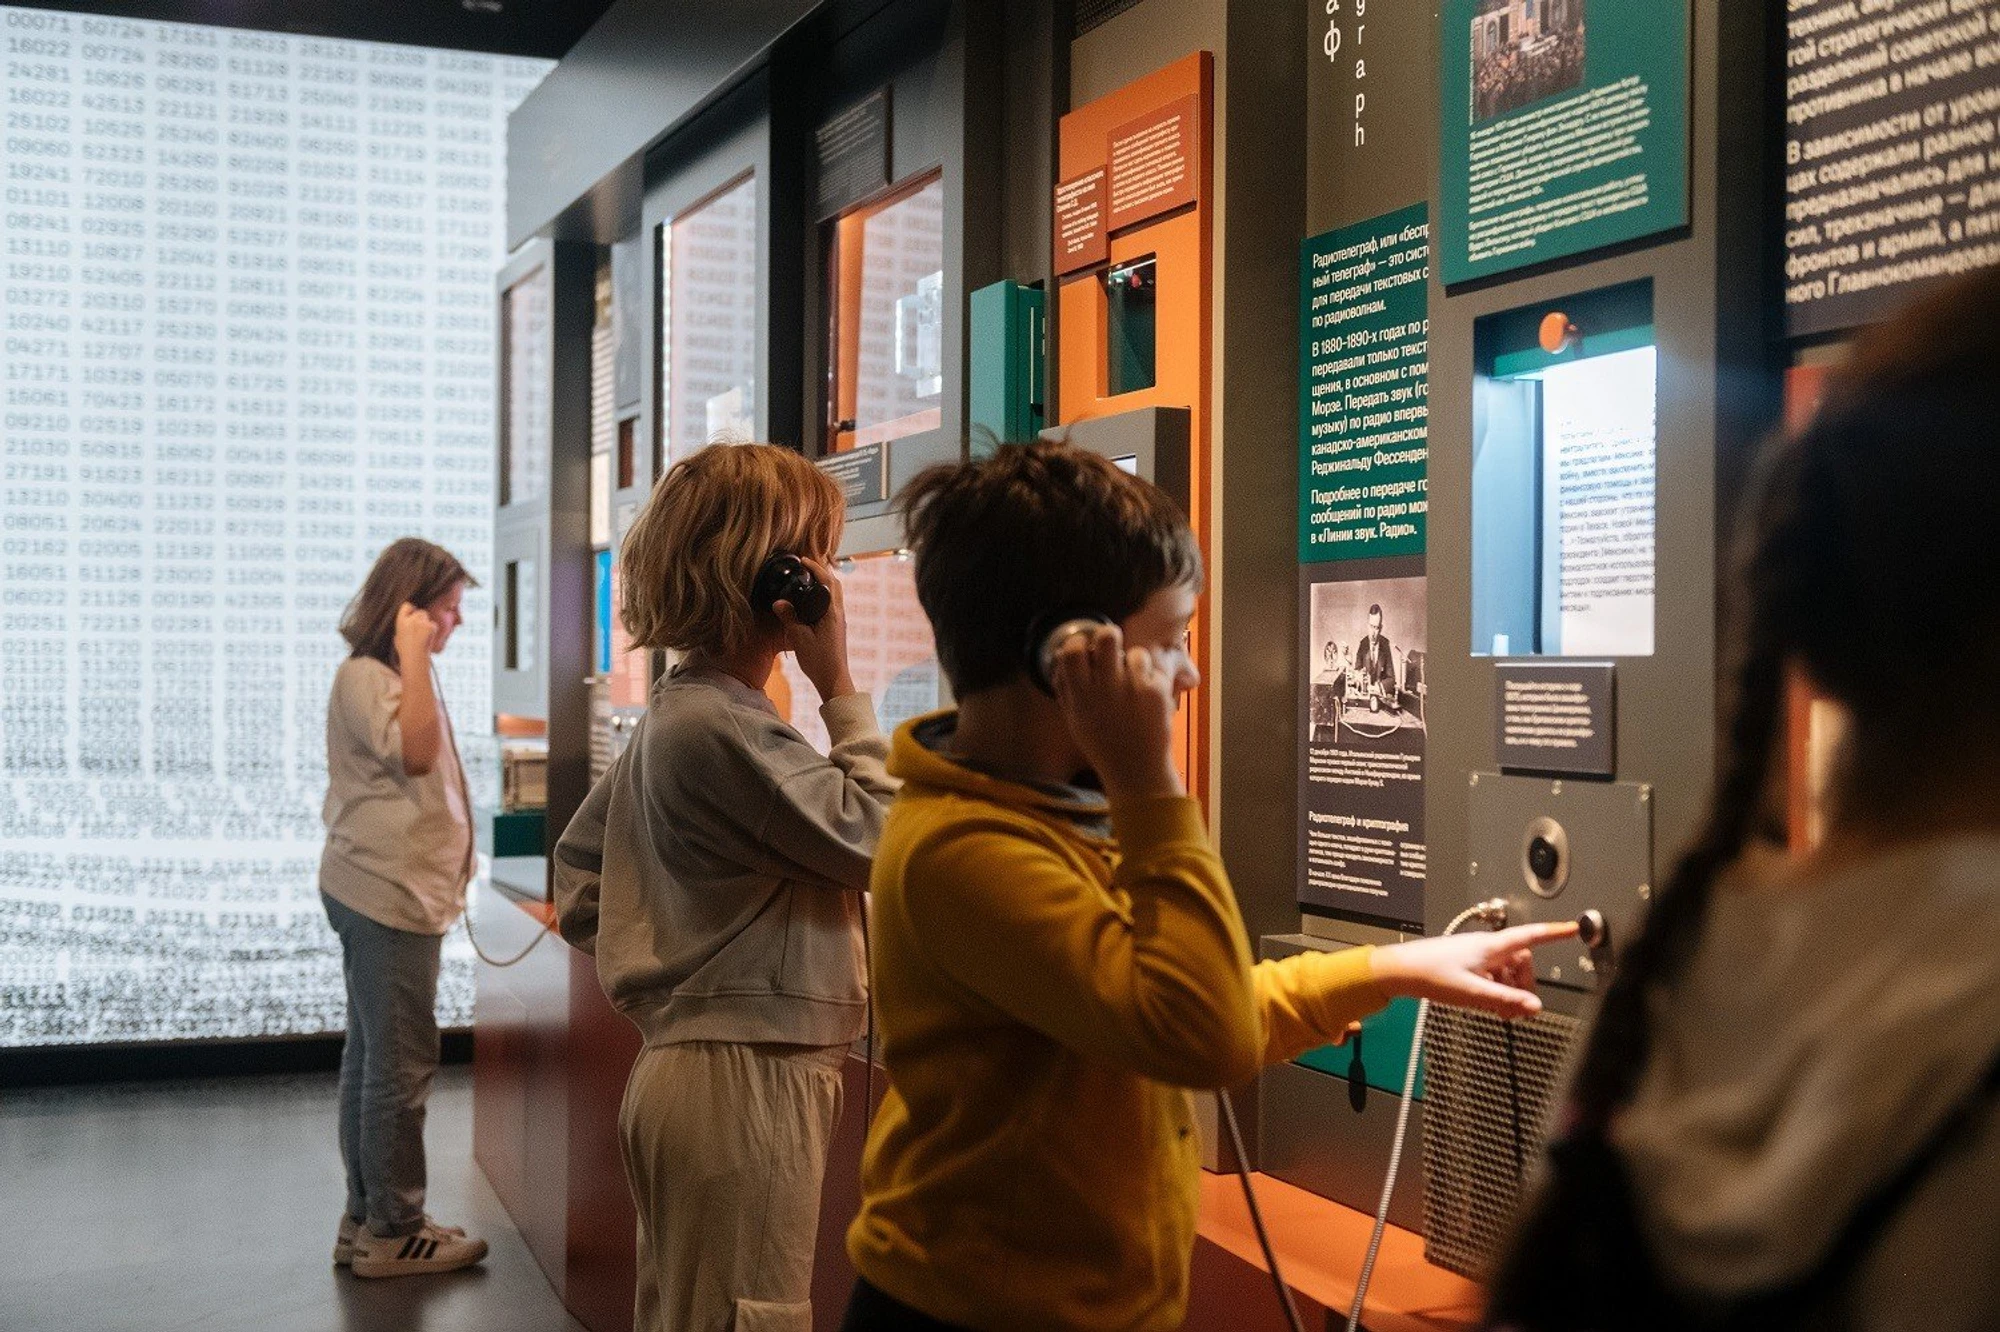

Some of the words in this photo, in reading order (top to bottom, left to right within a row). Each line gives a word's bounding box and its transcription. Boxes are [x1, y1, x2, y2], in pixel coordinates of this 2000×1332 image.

[1313, 236, 1378, 269] Радиотелеграф,
[1380, 234, 1397, 249] или
[1312, 270, 1331, 289] ный
[1388, 252, 1404, 267] это
[1312, 294, 1328, 311] для
[1329, 282, 1371, 304] передачи
[1373, 271, 1421, 291] текстовых
[1312, 316, 1323, 328] по
[1324, 299, 1387, 328] радиоволнам.
[1312, 341, 1320, 357] В
[1380, 326, 1406, 343] годах
[1407, 321, 1421, 334] по
[1312, 355, 1365, 378] передавали
[1366, 347, 1399, 365] только
[1312, 379, 1343, 397] щения,
[1345, 378, 1351, 390] в
[1352, 368, 1399, 388] основном
[1401, 366, 1408, 379] с
[1312, 400, 1343, 417] Морзе.
[1344, 393, 1389, 411] Передать
[1390, 387, 1413, 403] звук
[1311, 415, 1348, 439] музыку)
[1349, 418, 1361, 429] по
[1363, 411, 1392, 430] радио
[1311, 455, 1372, 476] Реджинальду
[1311, 486, 1361, 505] Подробнее
[1362, 486, 1369, 498] о
[1370, 480, 1416, 499] передаче
[1310, 504, 1362, 524] сообщений
[1364, 506, 1376, 519] по
[1377, 502, 1407, 520] радио
[1310, 533, 1316, 544] в
[1355, 527, 1378, 542] звук.
